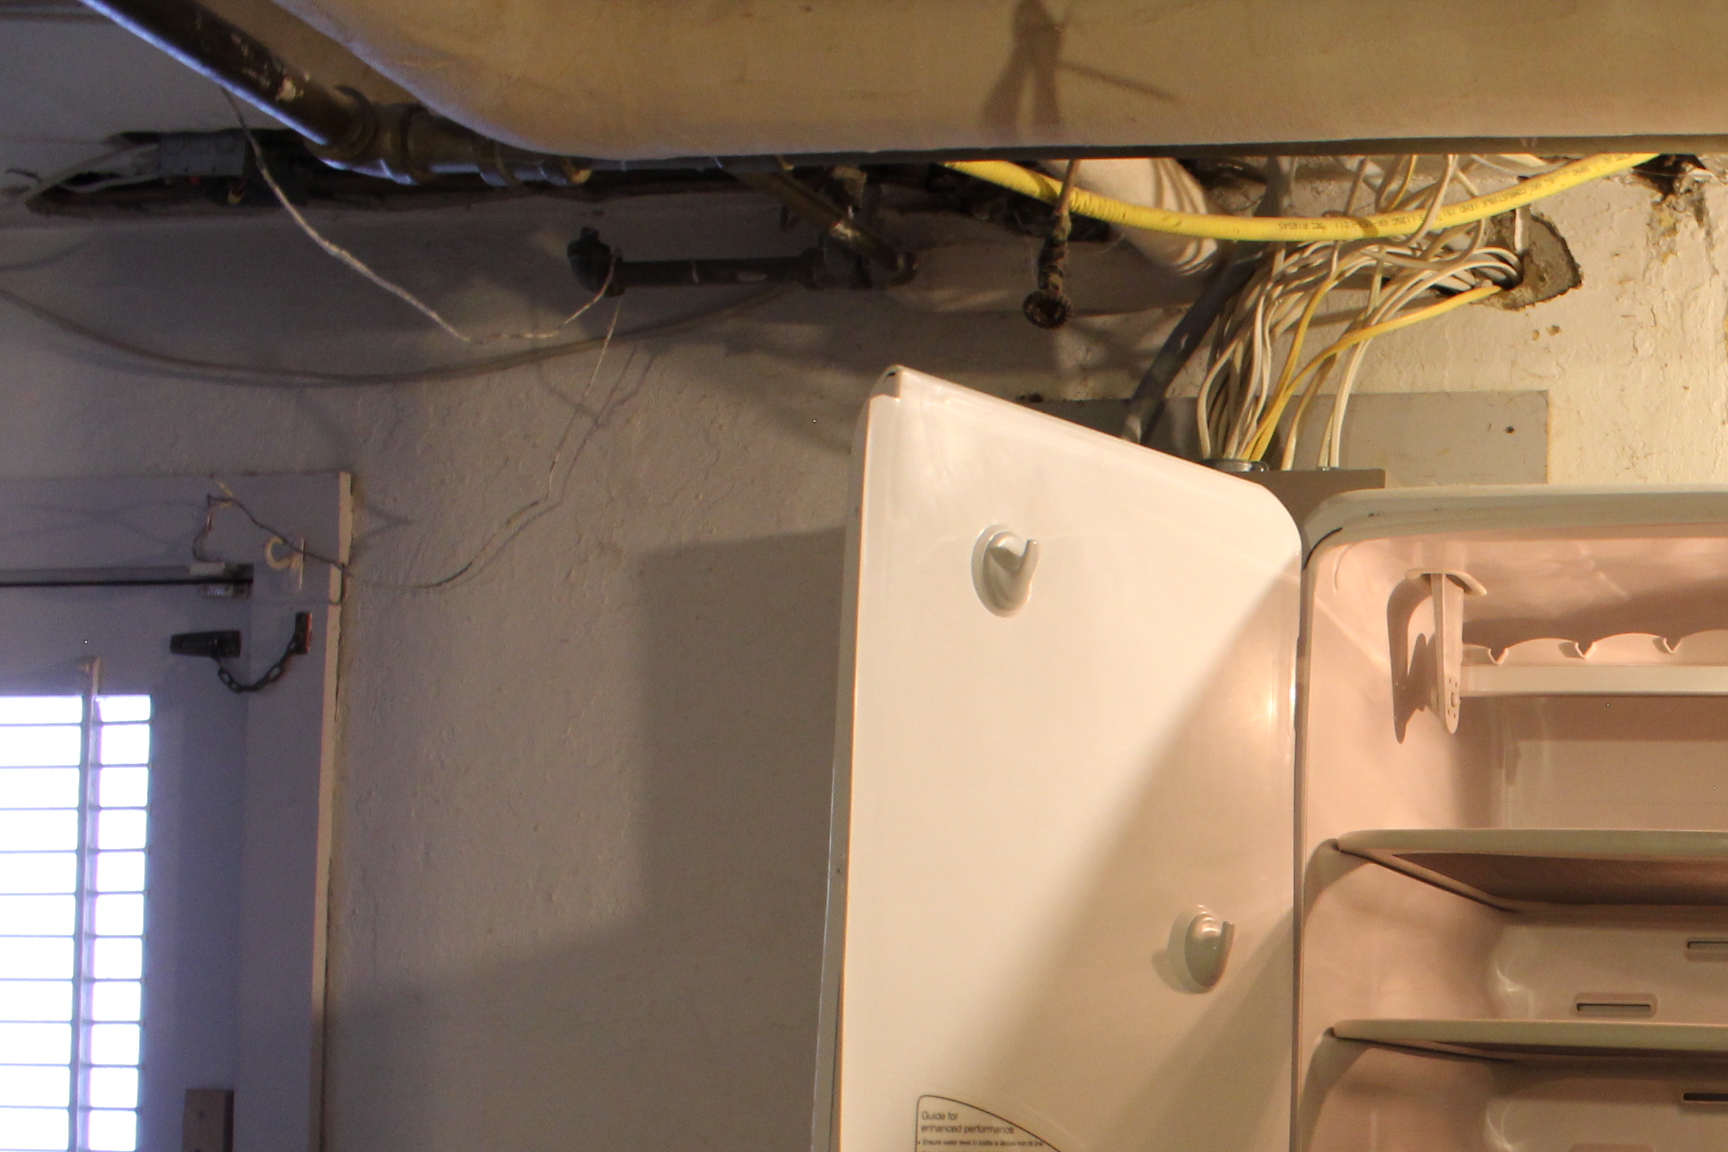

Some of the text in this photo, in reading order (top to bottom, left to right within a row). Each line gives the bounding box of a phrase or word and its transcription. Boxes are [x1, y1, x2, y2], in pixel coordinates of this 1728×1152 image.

[922, 1111, 958, 1120] Guide for
[964, 1125, 1014, 1134] performance
